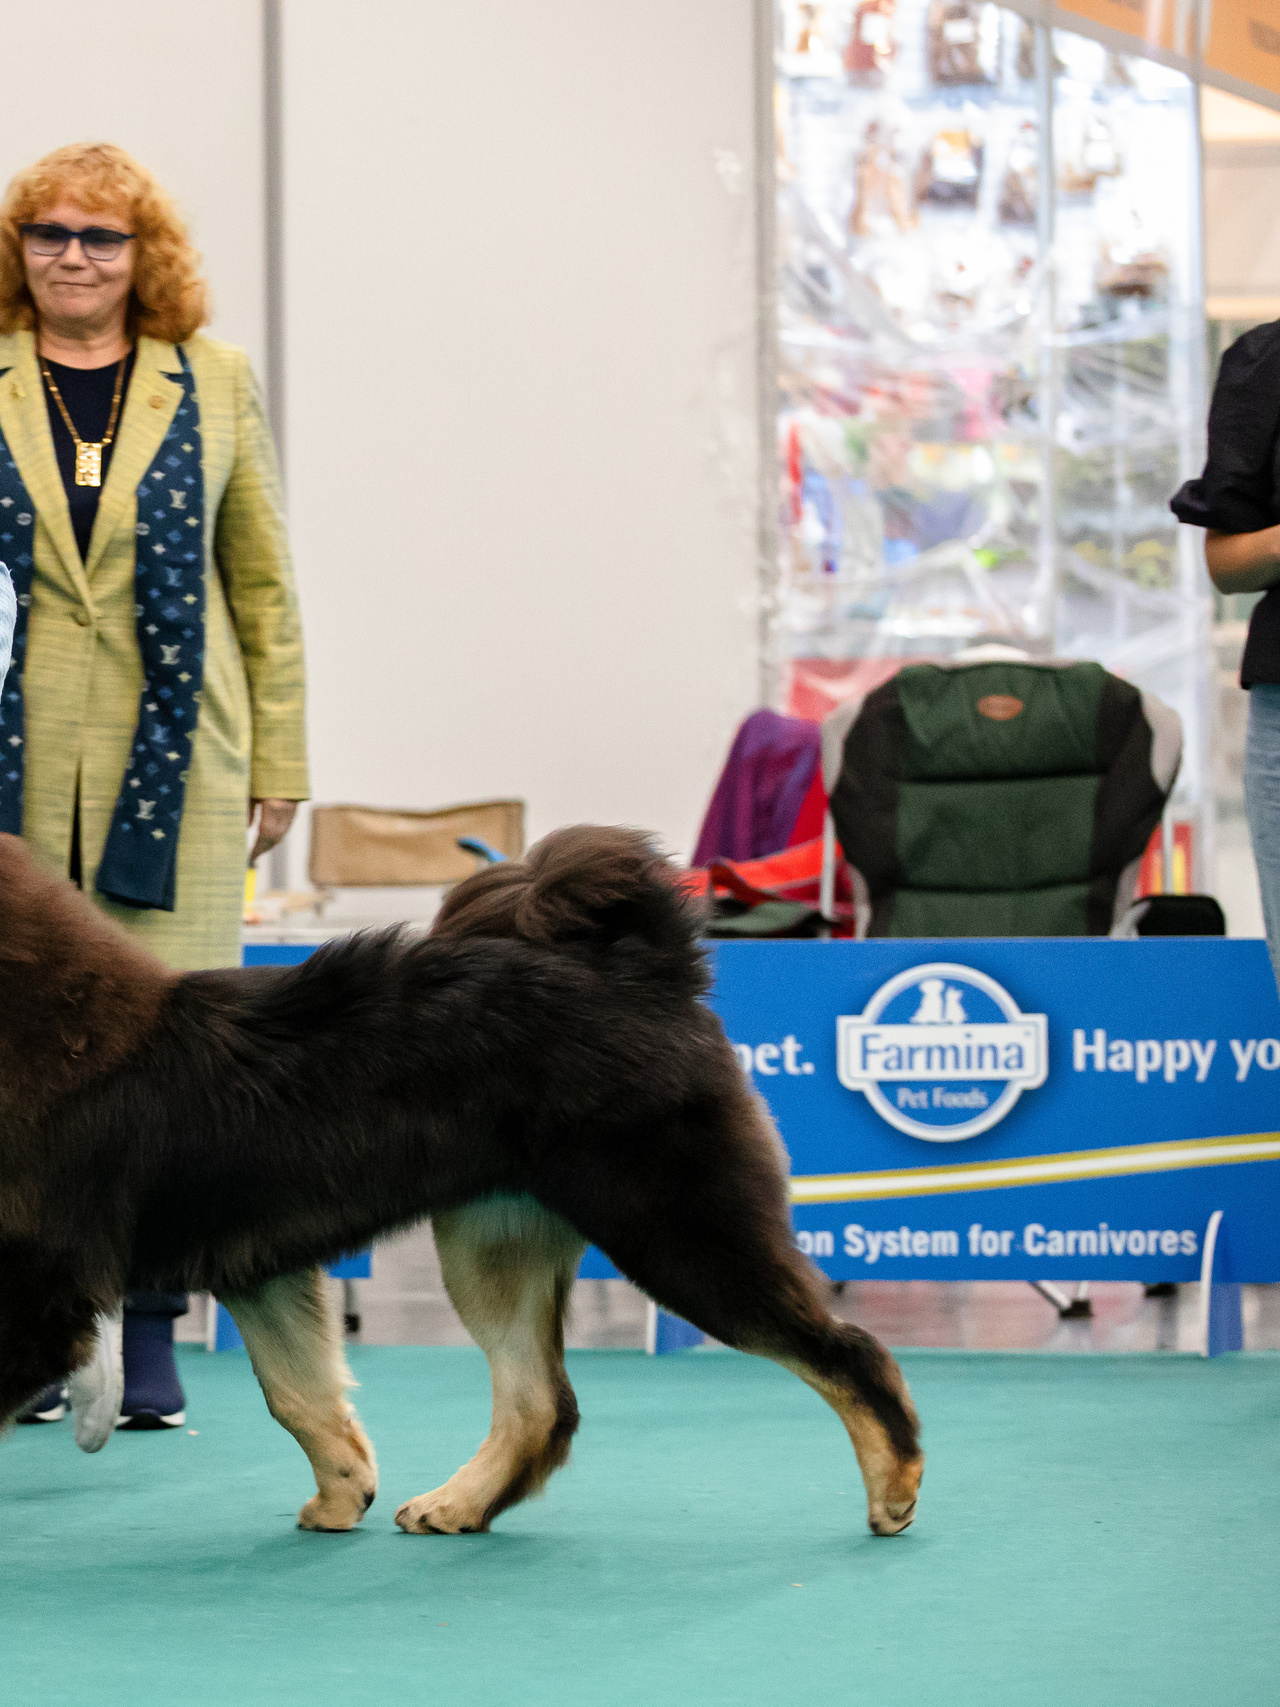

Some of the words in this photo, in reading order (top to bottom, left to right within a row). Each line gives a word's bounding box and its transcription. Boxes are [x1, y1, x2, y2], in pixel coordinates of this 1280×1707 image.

[860, 1032, 1024, 1071] Farmina
[1073, 1028, 1217, 1083] Happy
[897, 1087, 929, 1109] Pet
[932, 1086, 989, 1109] Foods
[843, 1223, 959, 1264] System
[968, 1223, 1014, 1256] for
[1023, 1222, 1198, 1257] Carnivores
